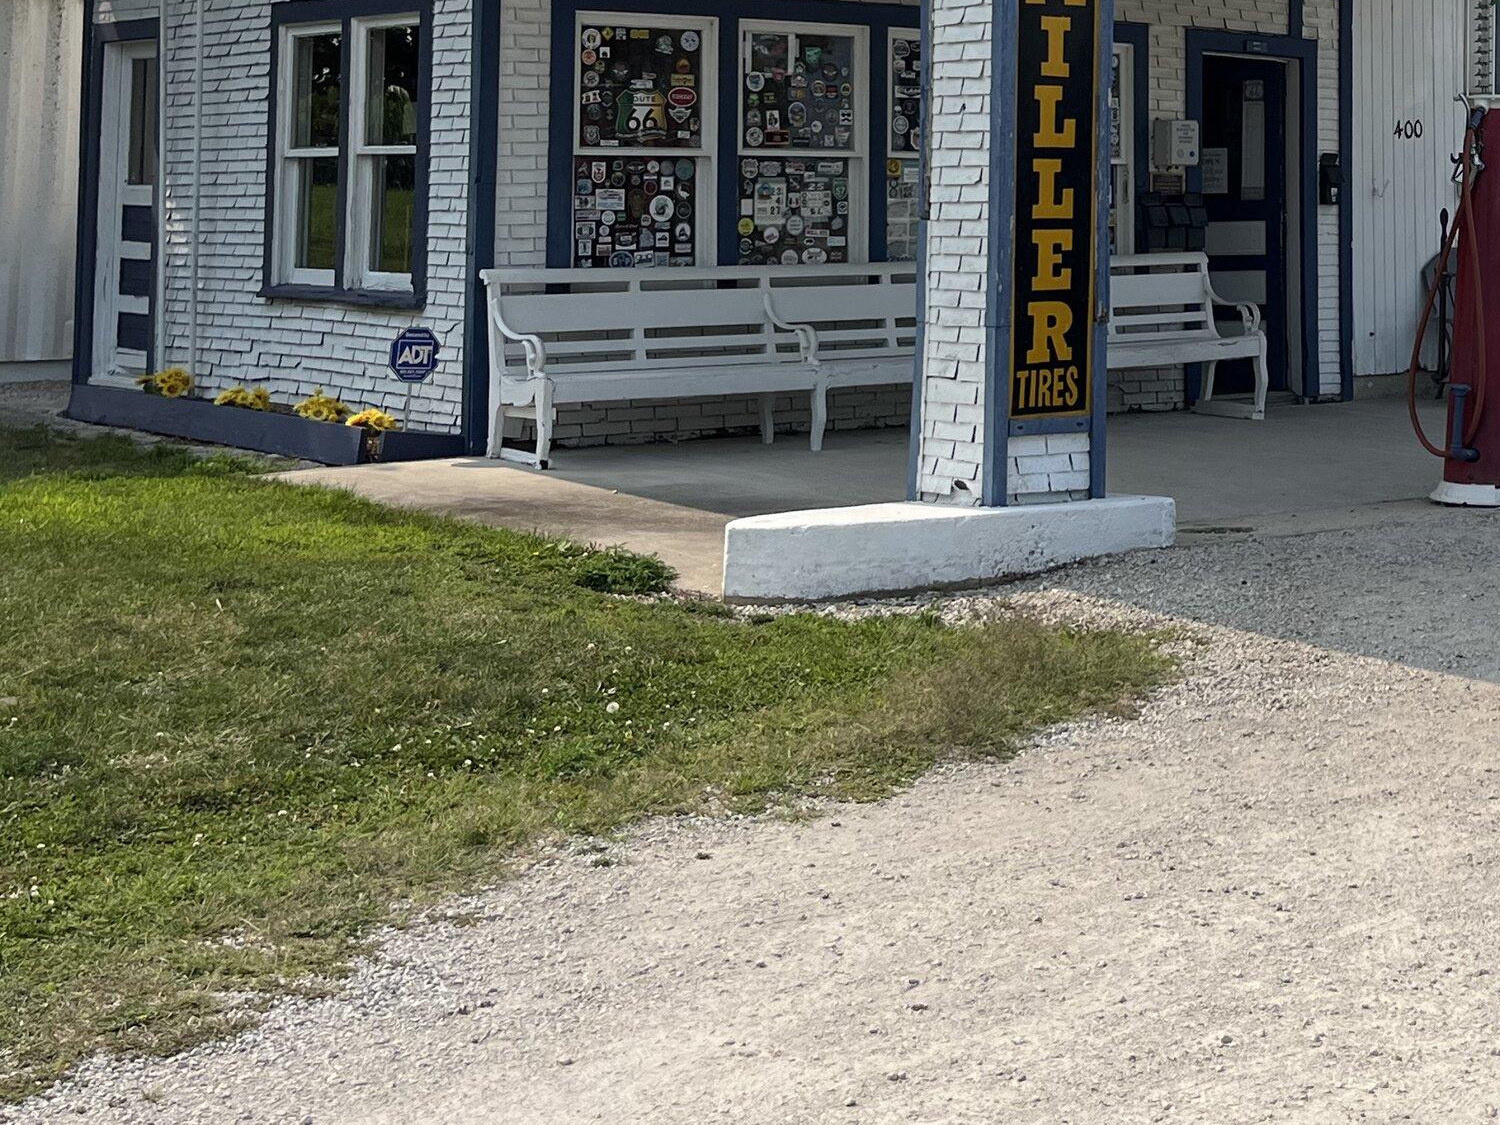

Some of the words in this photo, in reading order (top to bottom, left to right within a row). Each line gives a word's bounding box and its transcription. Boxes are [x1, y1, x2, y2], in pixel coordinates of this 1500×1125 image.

[626, 108, 658, 131] 66
[1394, 119, 1423, 139] 400
[397, 345, 433, 364] ADT
[1016, 365, 1078, 408] TIRES
